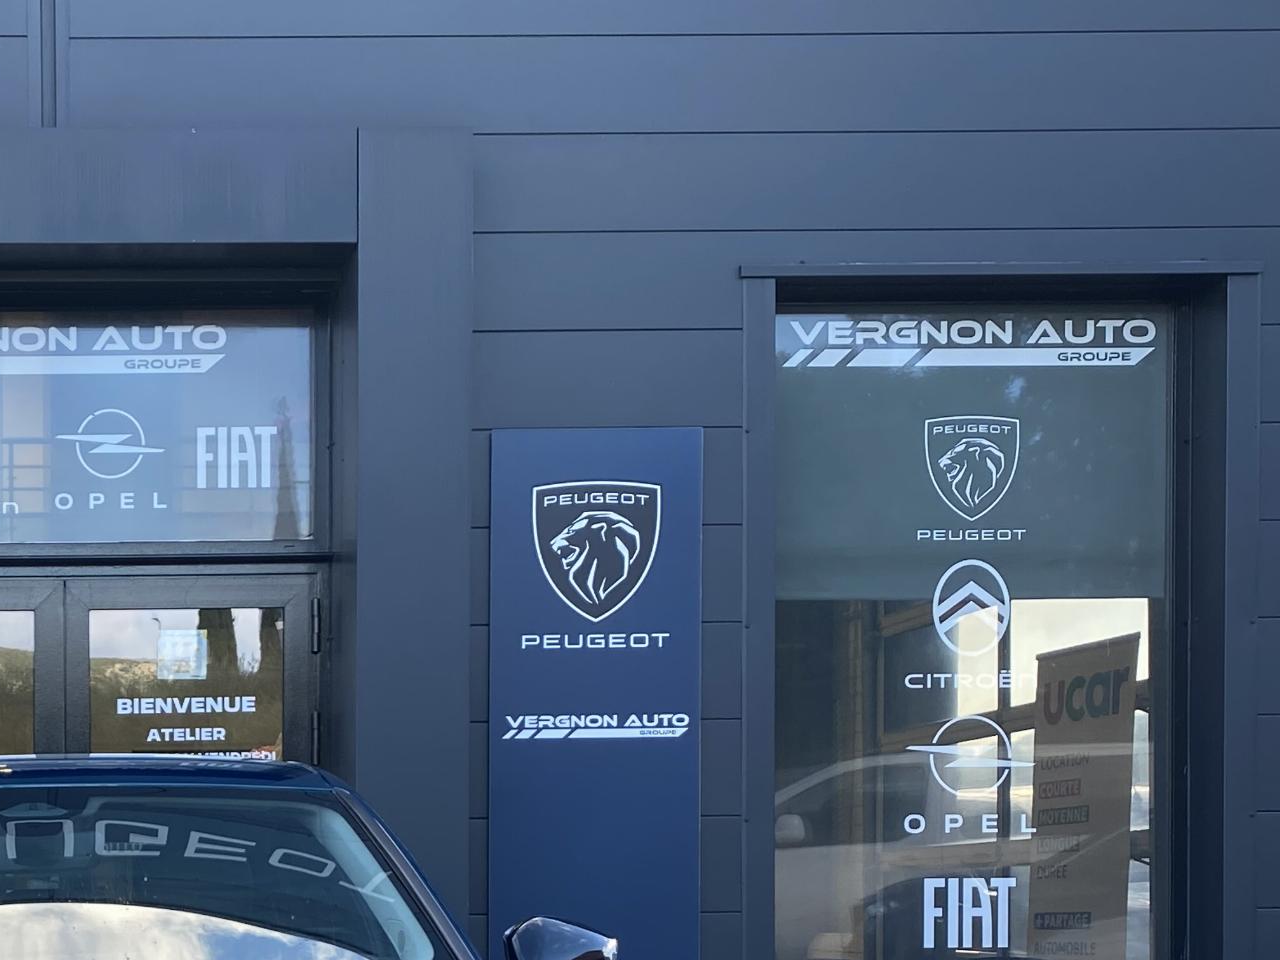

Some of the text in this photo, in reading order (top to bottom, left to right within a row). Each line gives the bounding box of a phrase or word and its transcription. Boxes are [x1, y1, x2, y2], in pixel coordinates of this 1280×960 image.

[92, 325, 227, 351] AUTO
[790, 319, 1156, 345] VERGNON AUTO
[123, 358, 202, 370] GROUPE
[1057, 351, 1132, 362] GROUPE
[932, 424, 1012, 435] PEUGEOT
[196, 426, 277, 488] FIAT
[55, 492, 167, 511] OPEL
[543, 492, 650, 507] PEUGEOT
[916, 528, 1027, 541] PEUGEOT
[520, 632, 670, 649] PEUGEOT
[904, 669, 1038, 689] CITROË
[116, 696, 256, 715] BIENVENUE
[1043, 667, 1130, 726] ucar
[505, 713, 690, 728] VERGNON AUTO
[146, 727, 226, 742] ATELIER
[904, 813, 1037, 834] OPEL
[923, 877, 1017, 949] FIAT
